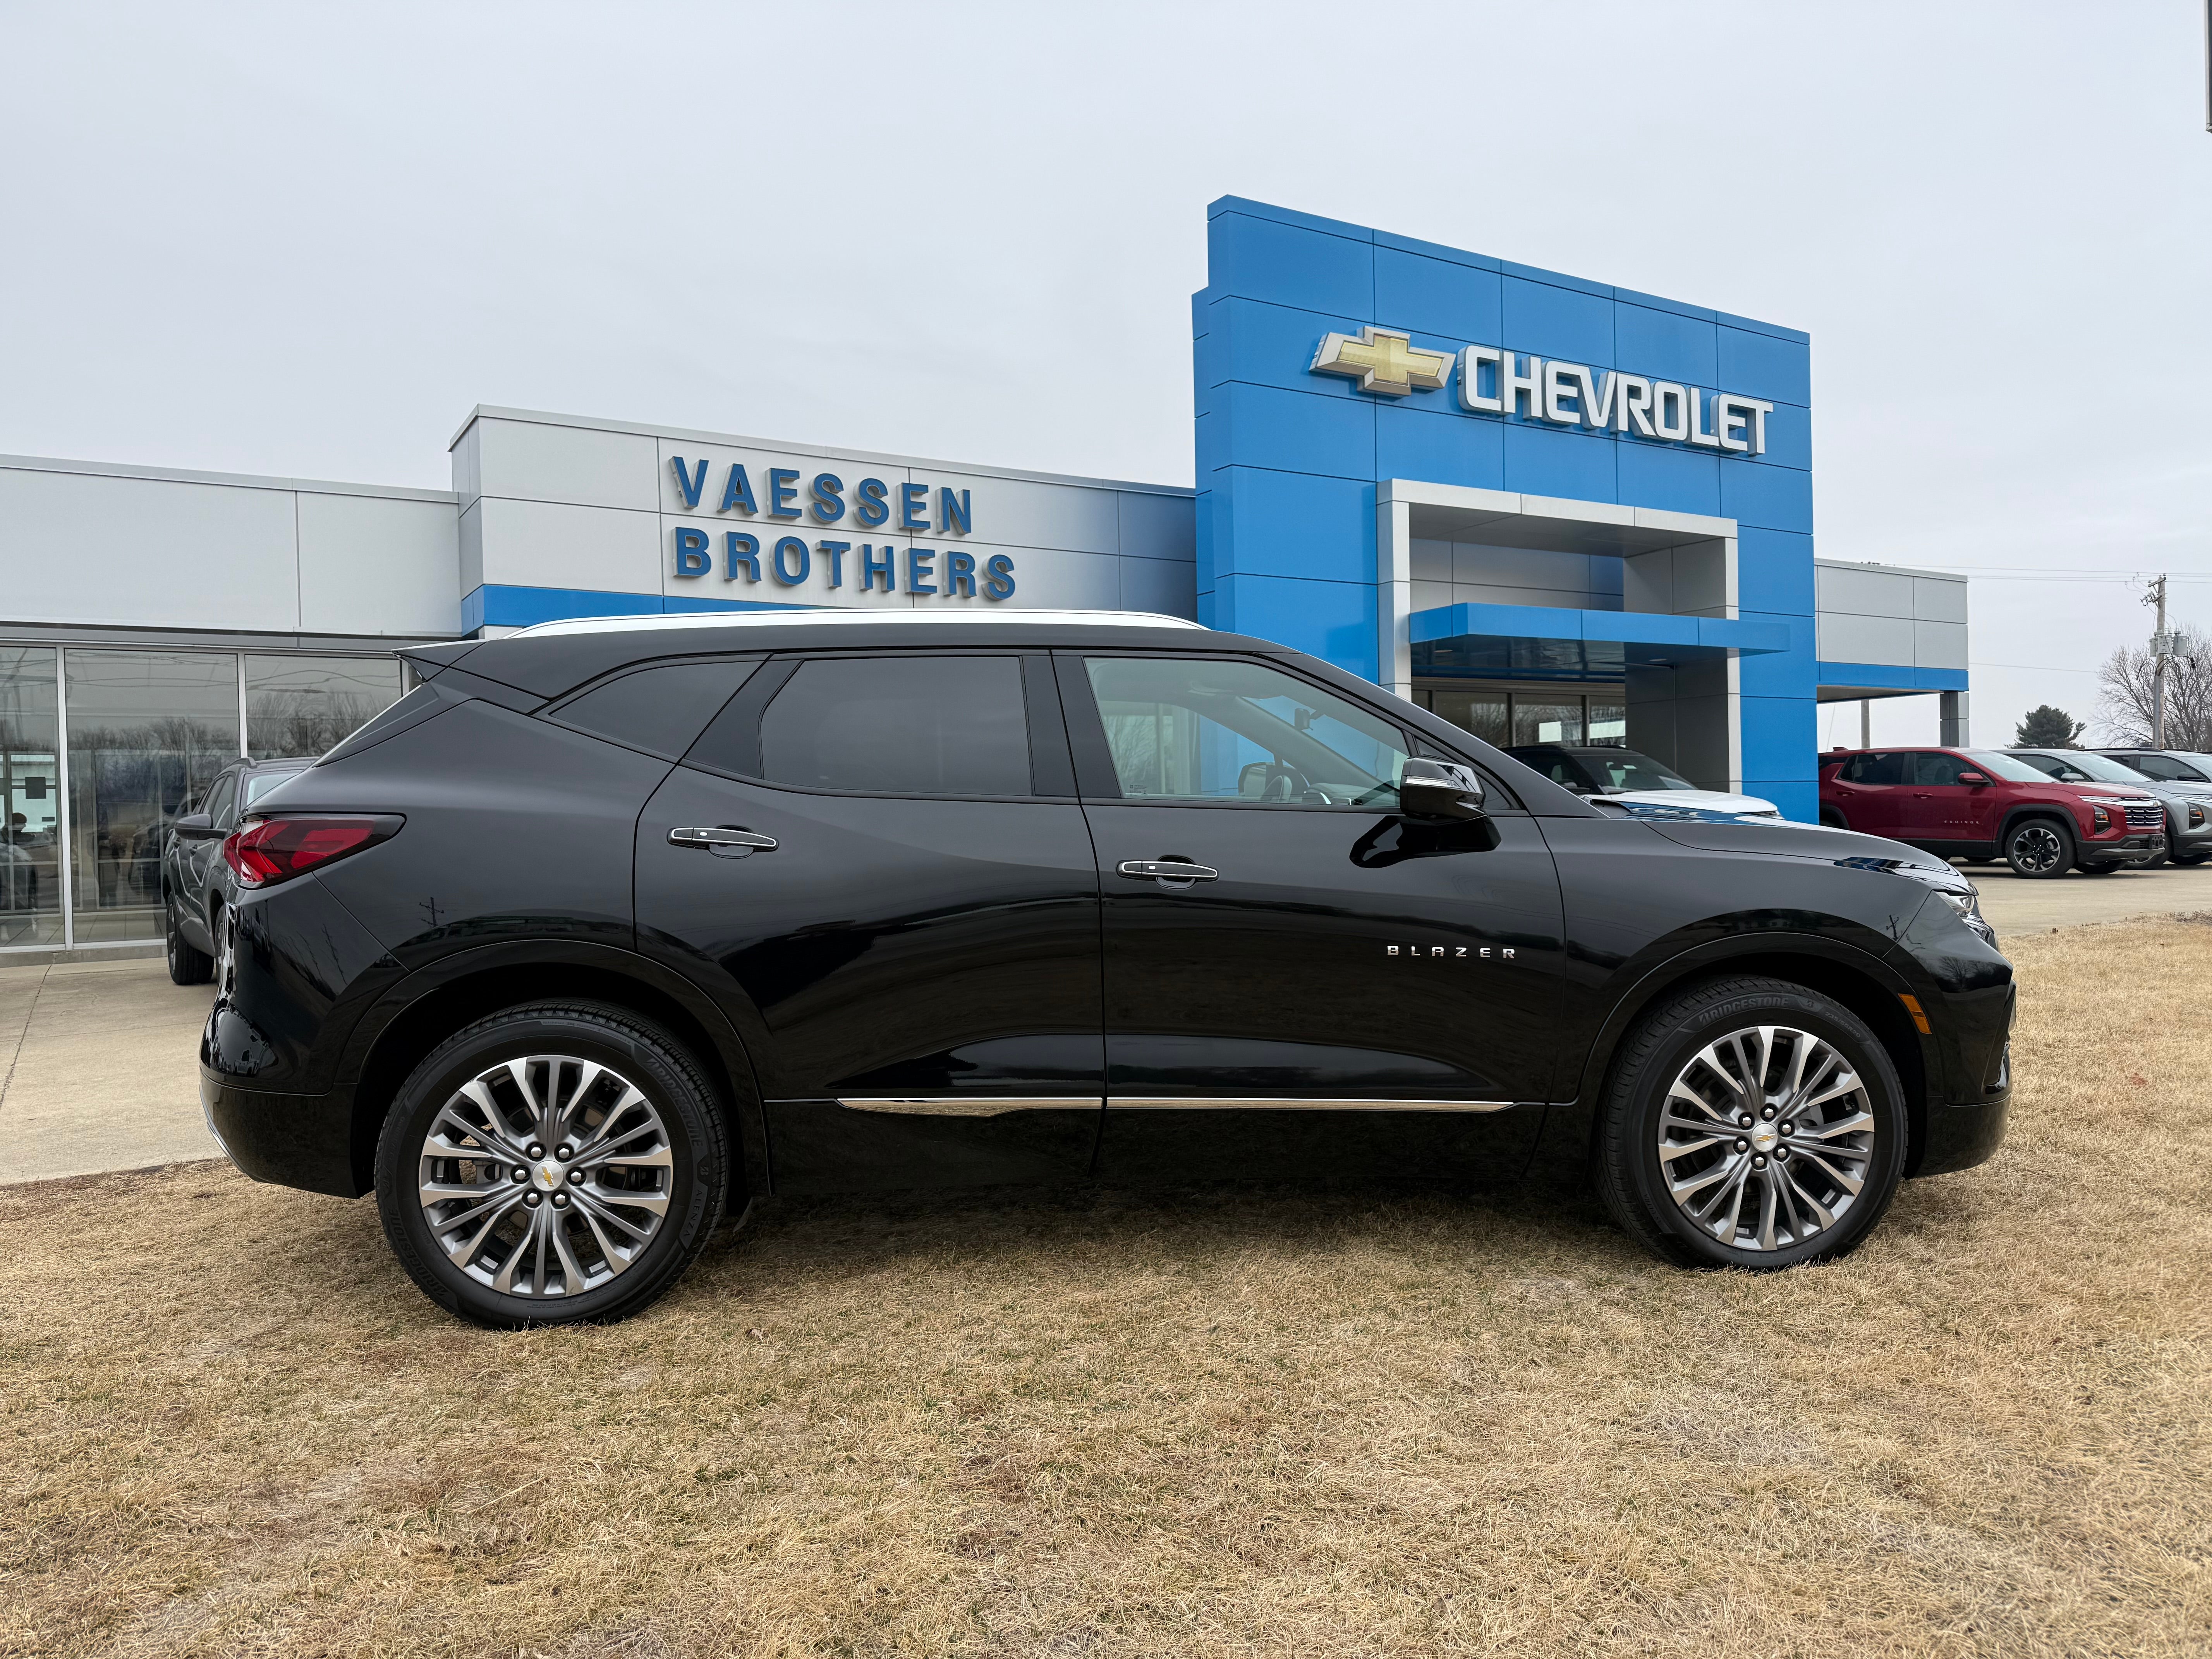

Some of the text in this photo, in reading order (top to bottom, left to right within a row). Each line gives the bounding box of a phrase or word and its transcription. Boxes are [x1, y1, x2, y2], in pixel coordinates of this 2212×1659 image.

[1457, 345, 1773, 456] CHEVROLET
[669, 456, 971, 536] VAESSEN
[672, 527, 1015, 600] BROTHERS
[1387, 945, 1515, 958] BLAZER
[1699, 996, 1789, 1024] BRIDGESTONE
[643, 1058, 704, 1147] BRIDGESTONE
[683, 1188, 703, 1237] ALENZA
[388, 1208, 449, 1297] BRIDGESTONE
